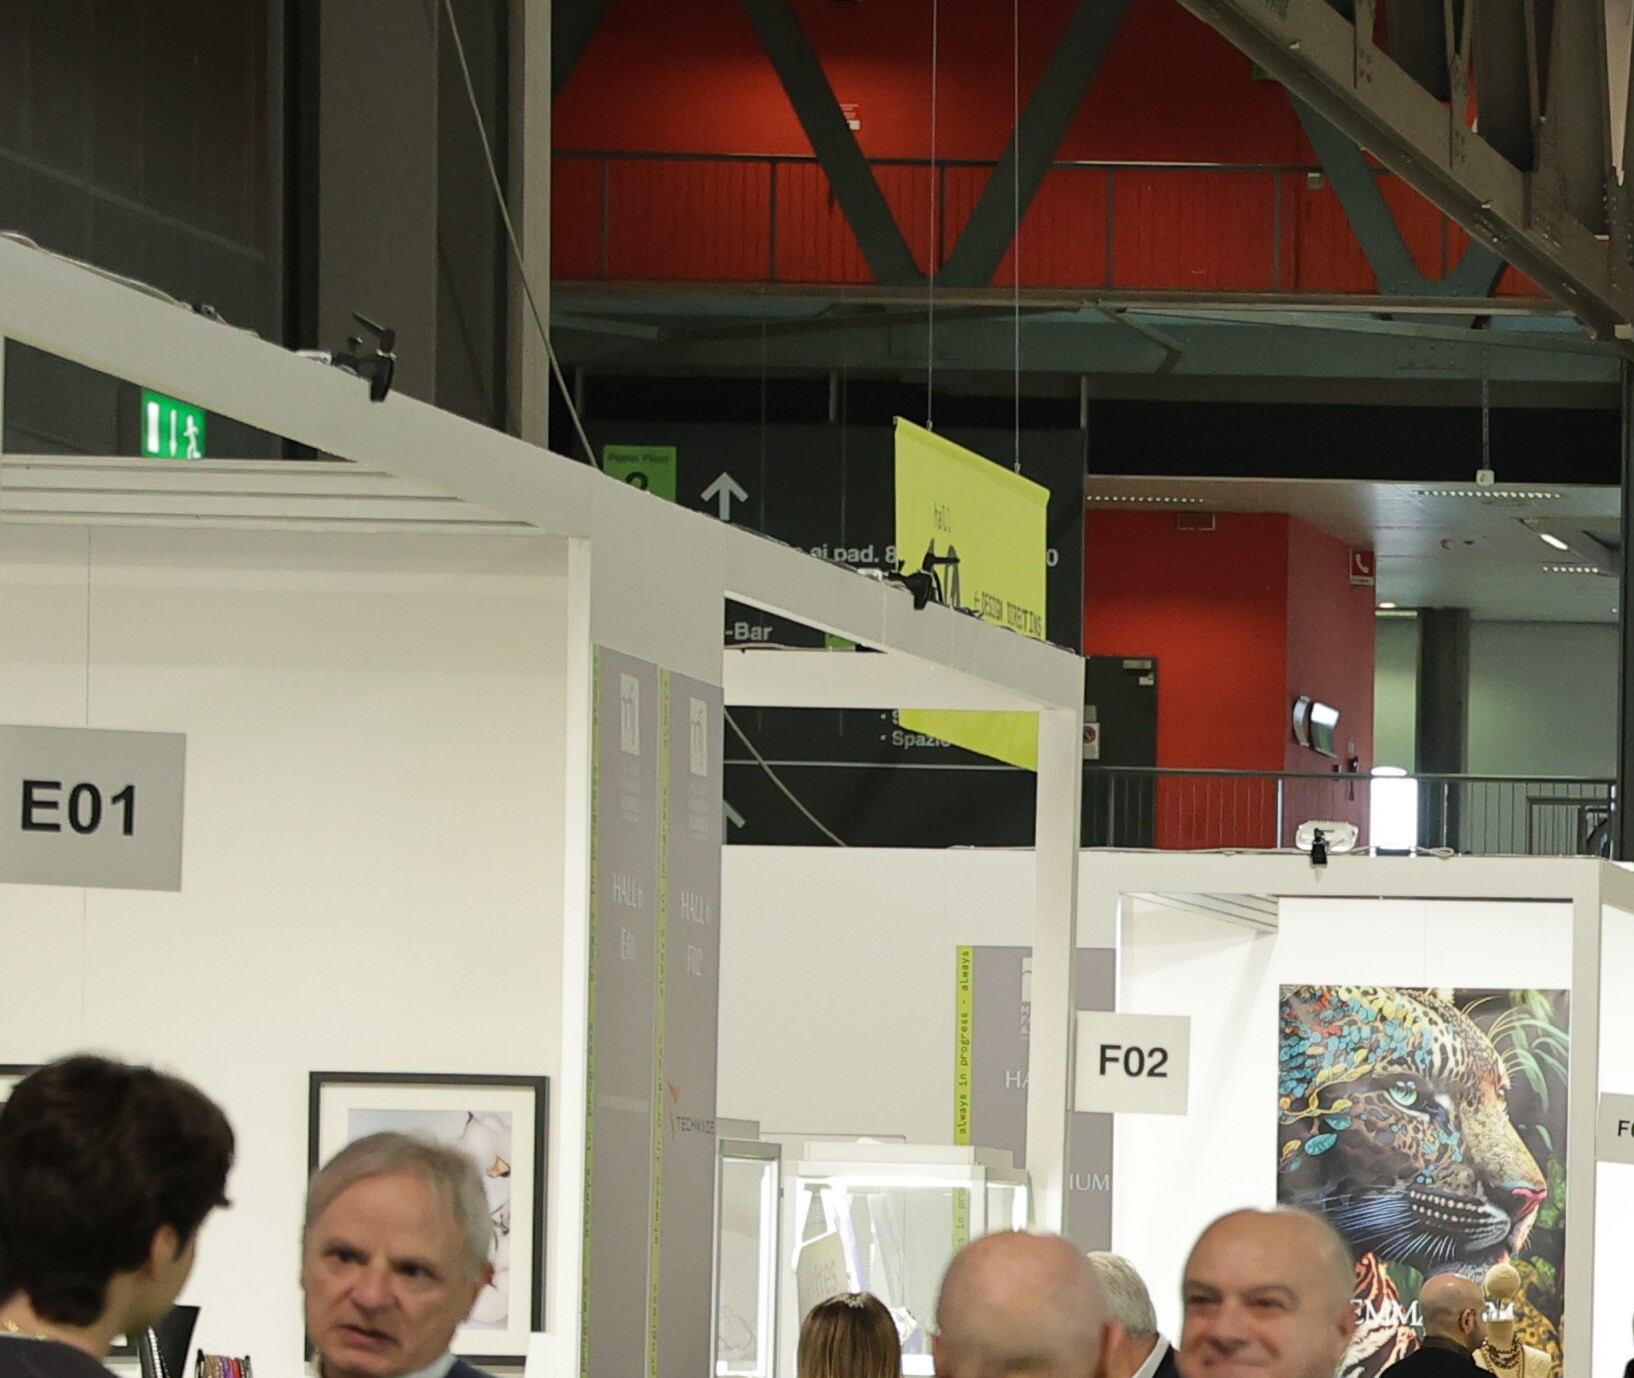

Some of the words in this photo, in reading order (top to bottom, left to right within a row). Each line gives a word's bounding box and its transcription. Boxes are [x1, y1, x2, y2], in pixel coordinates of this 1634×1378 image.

[20, 779, 136, 837] E01
[959, 950, 970, 992] always
[959, 1012, 970, 1066] progress
[1099, 1044, 1169, 1079] F02
[957, 1094, 969, 1134] always
